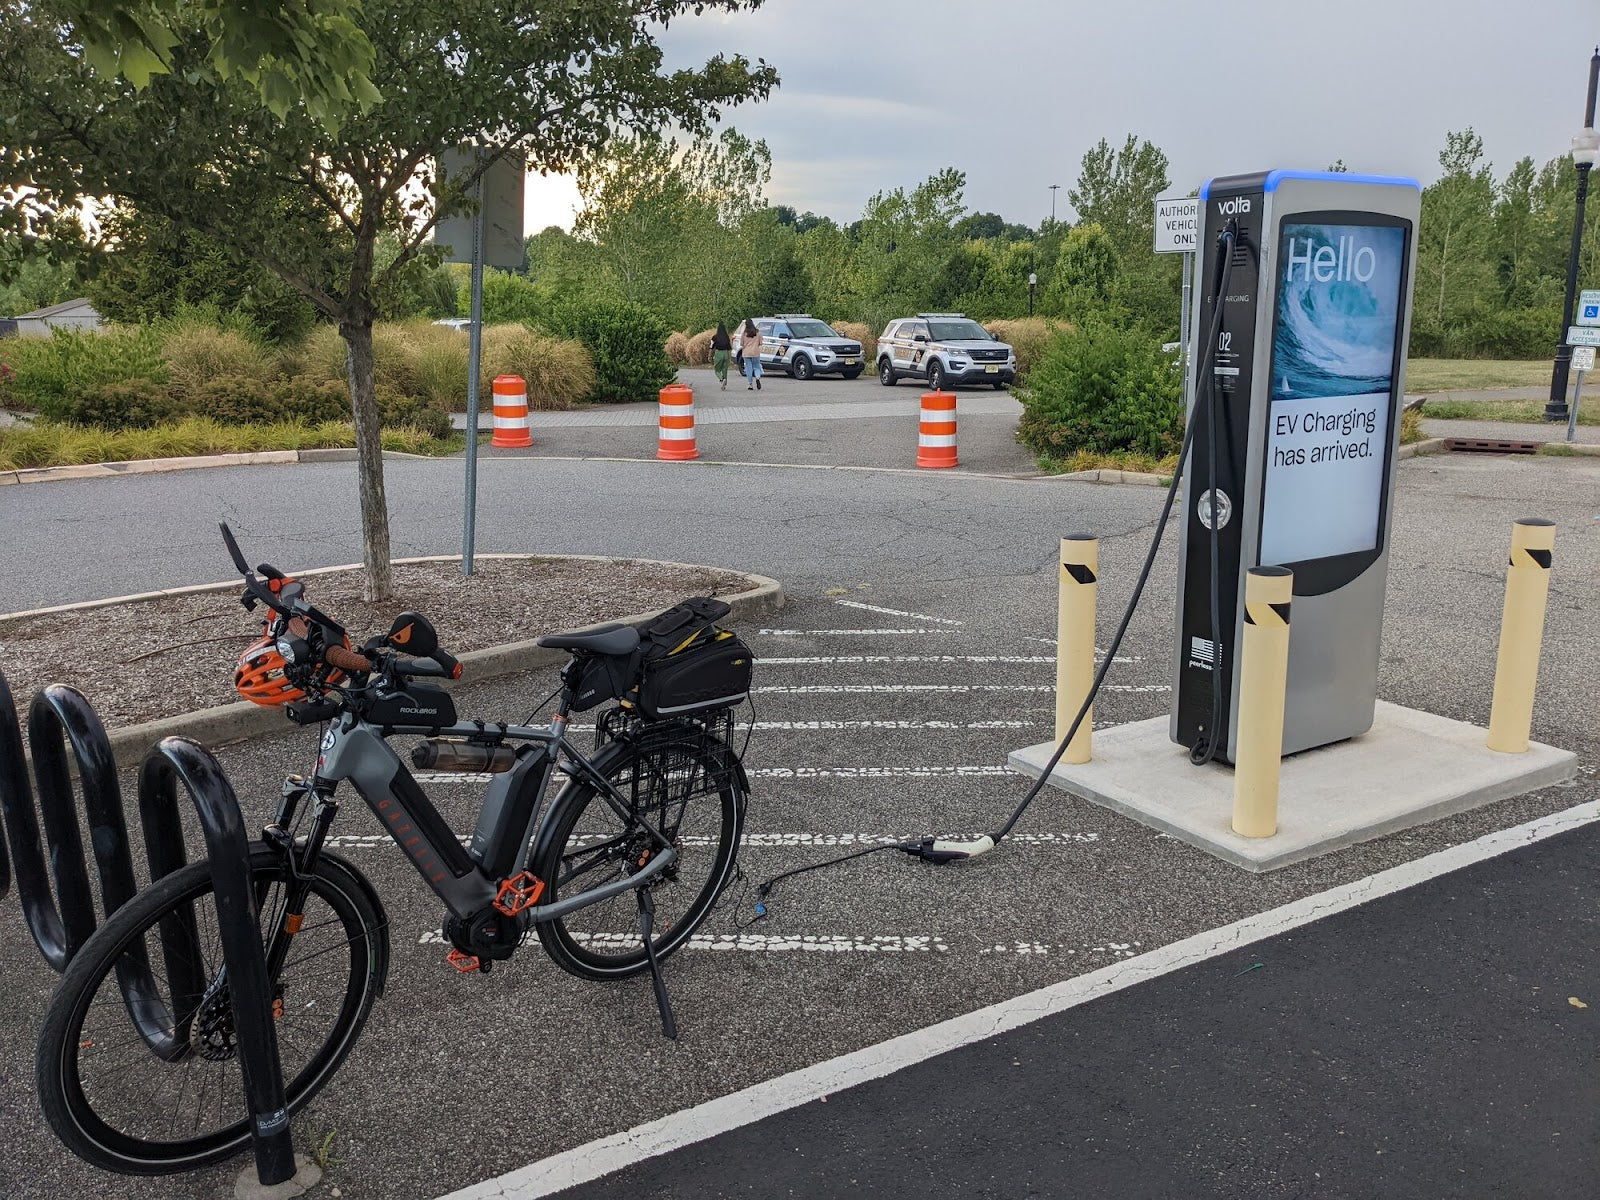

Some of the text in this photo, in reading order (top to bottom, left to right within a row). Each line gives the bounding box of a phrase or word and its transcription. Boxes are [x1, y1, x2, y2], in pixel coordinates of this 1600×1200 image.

[1159, 205, 1196, 217] AUTHOR
[1218, 196, 1251, 215] volta
[1165, 219, 1198, 231] VEHICL
[1174, 233, 1198, 245] ONL
[1287, 235, 1376, 283] Hello
[1225, 294, 1249, 303] ARGING
[1218, 331, 1232, 351] 02
[1276, 408, 1377, 436] EV Charging
[1274, 437, 1373, 467] has arrived.
[378, 799, 447, 884] GAZELLE
